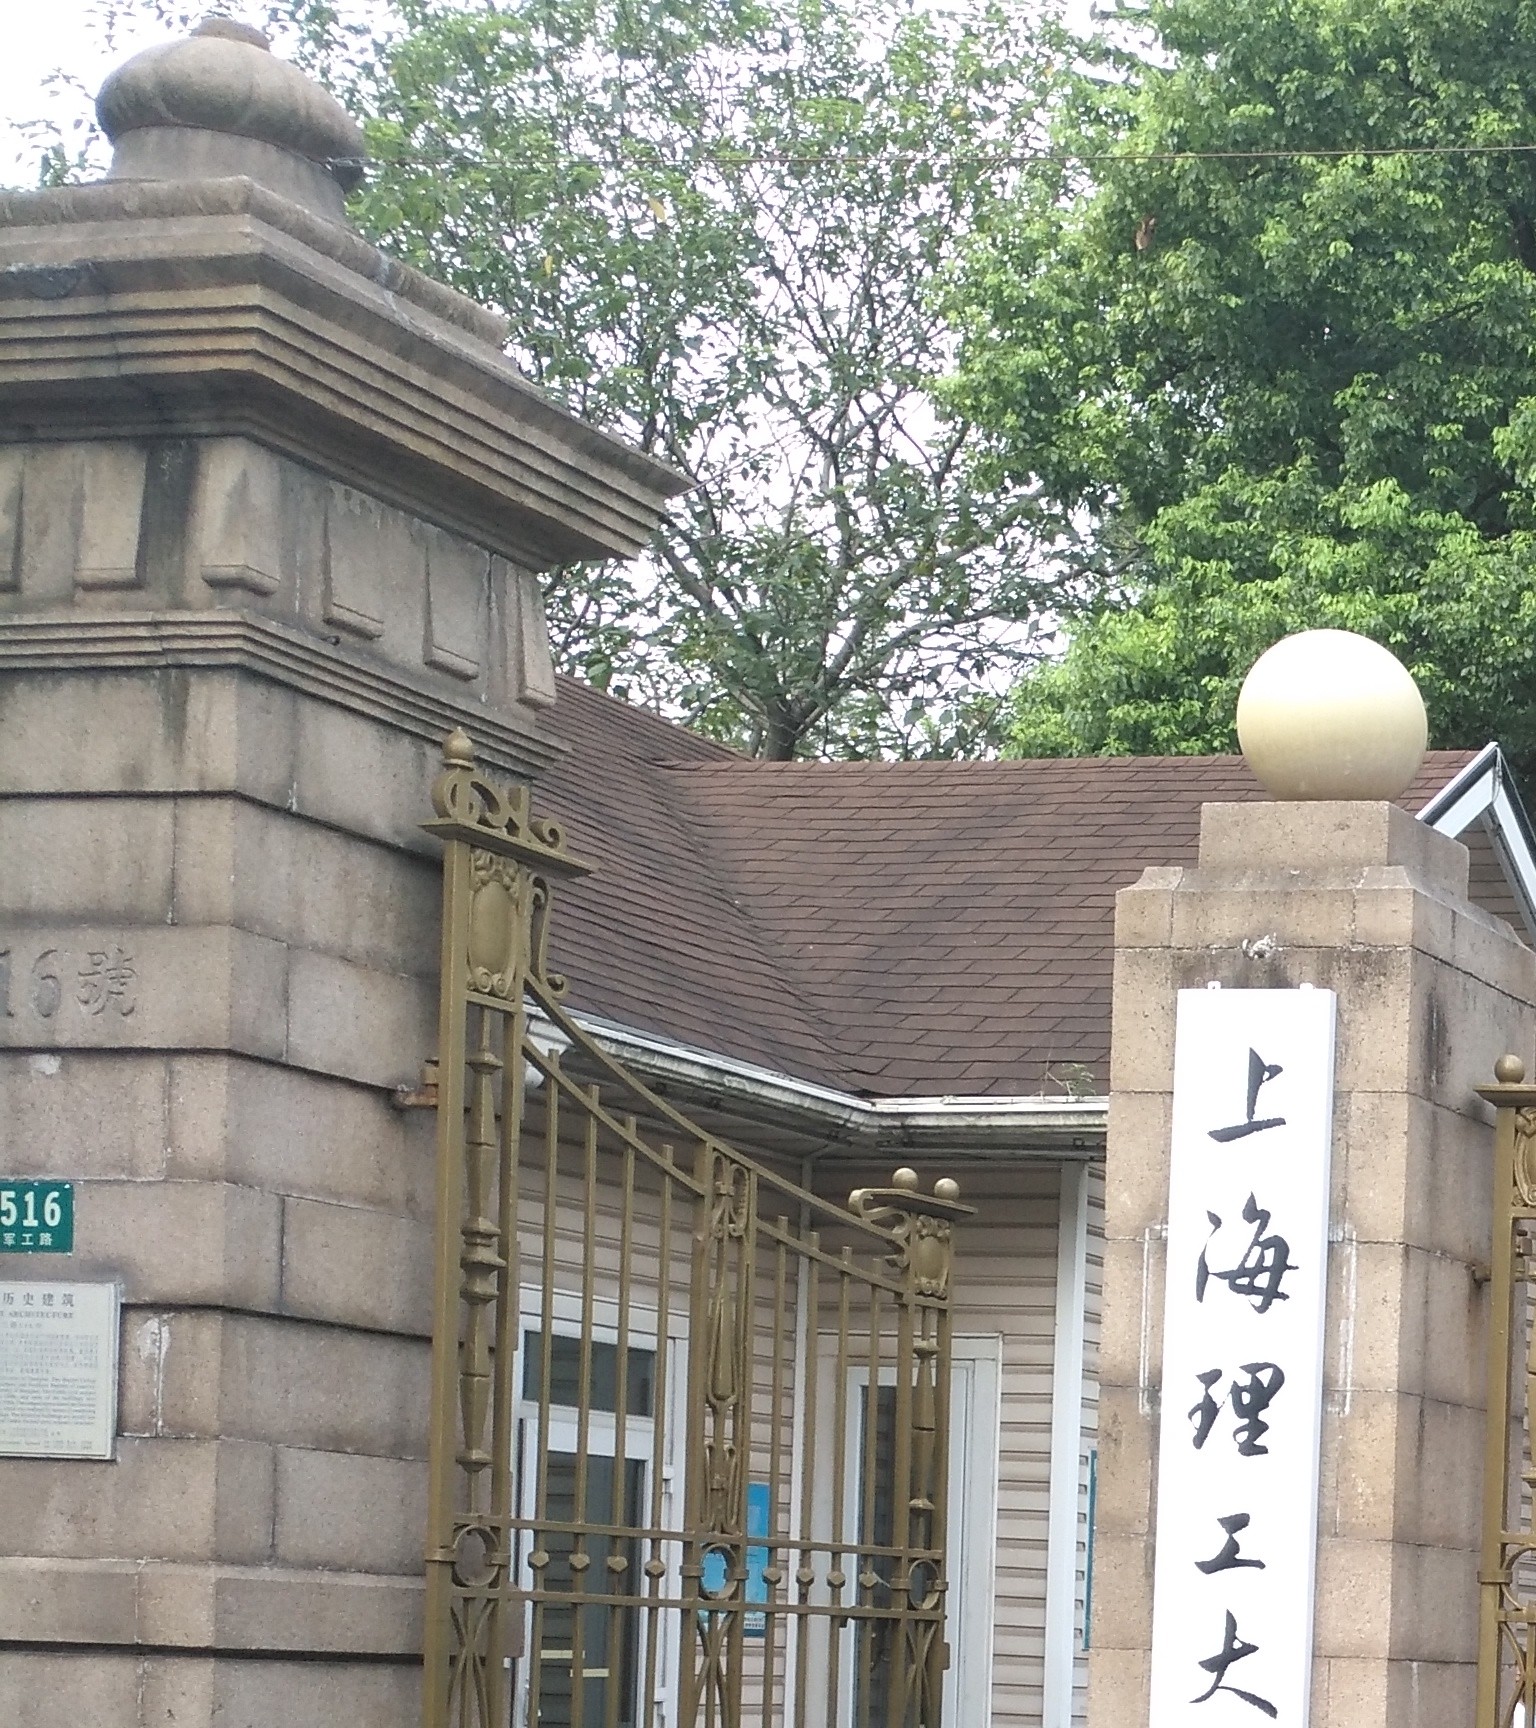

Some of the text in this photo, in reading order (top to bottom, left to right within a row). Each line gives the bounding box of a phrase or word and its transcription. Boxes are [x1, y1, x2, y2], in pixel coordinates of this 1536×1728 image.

[0, 1191, 61, 1227] 516
[3, 1232, 53, 1246] 军工路
